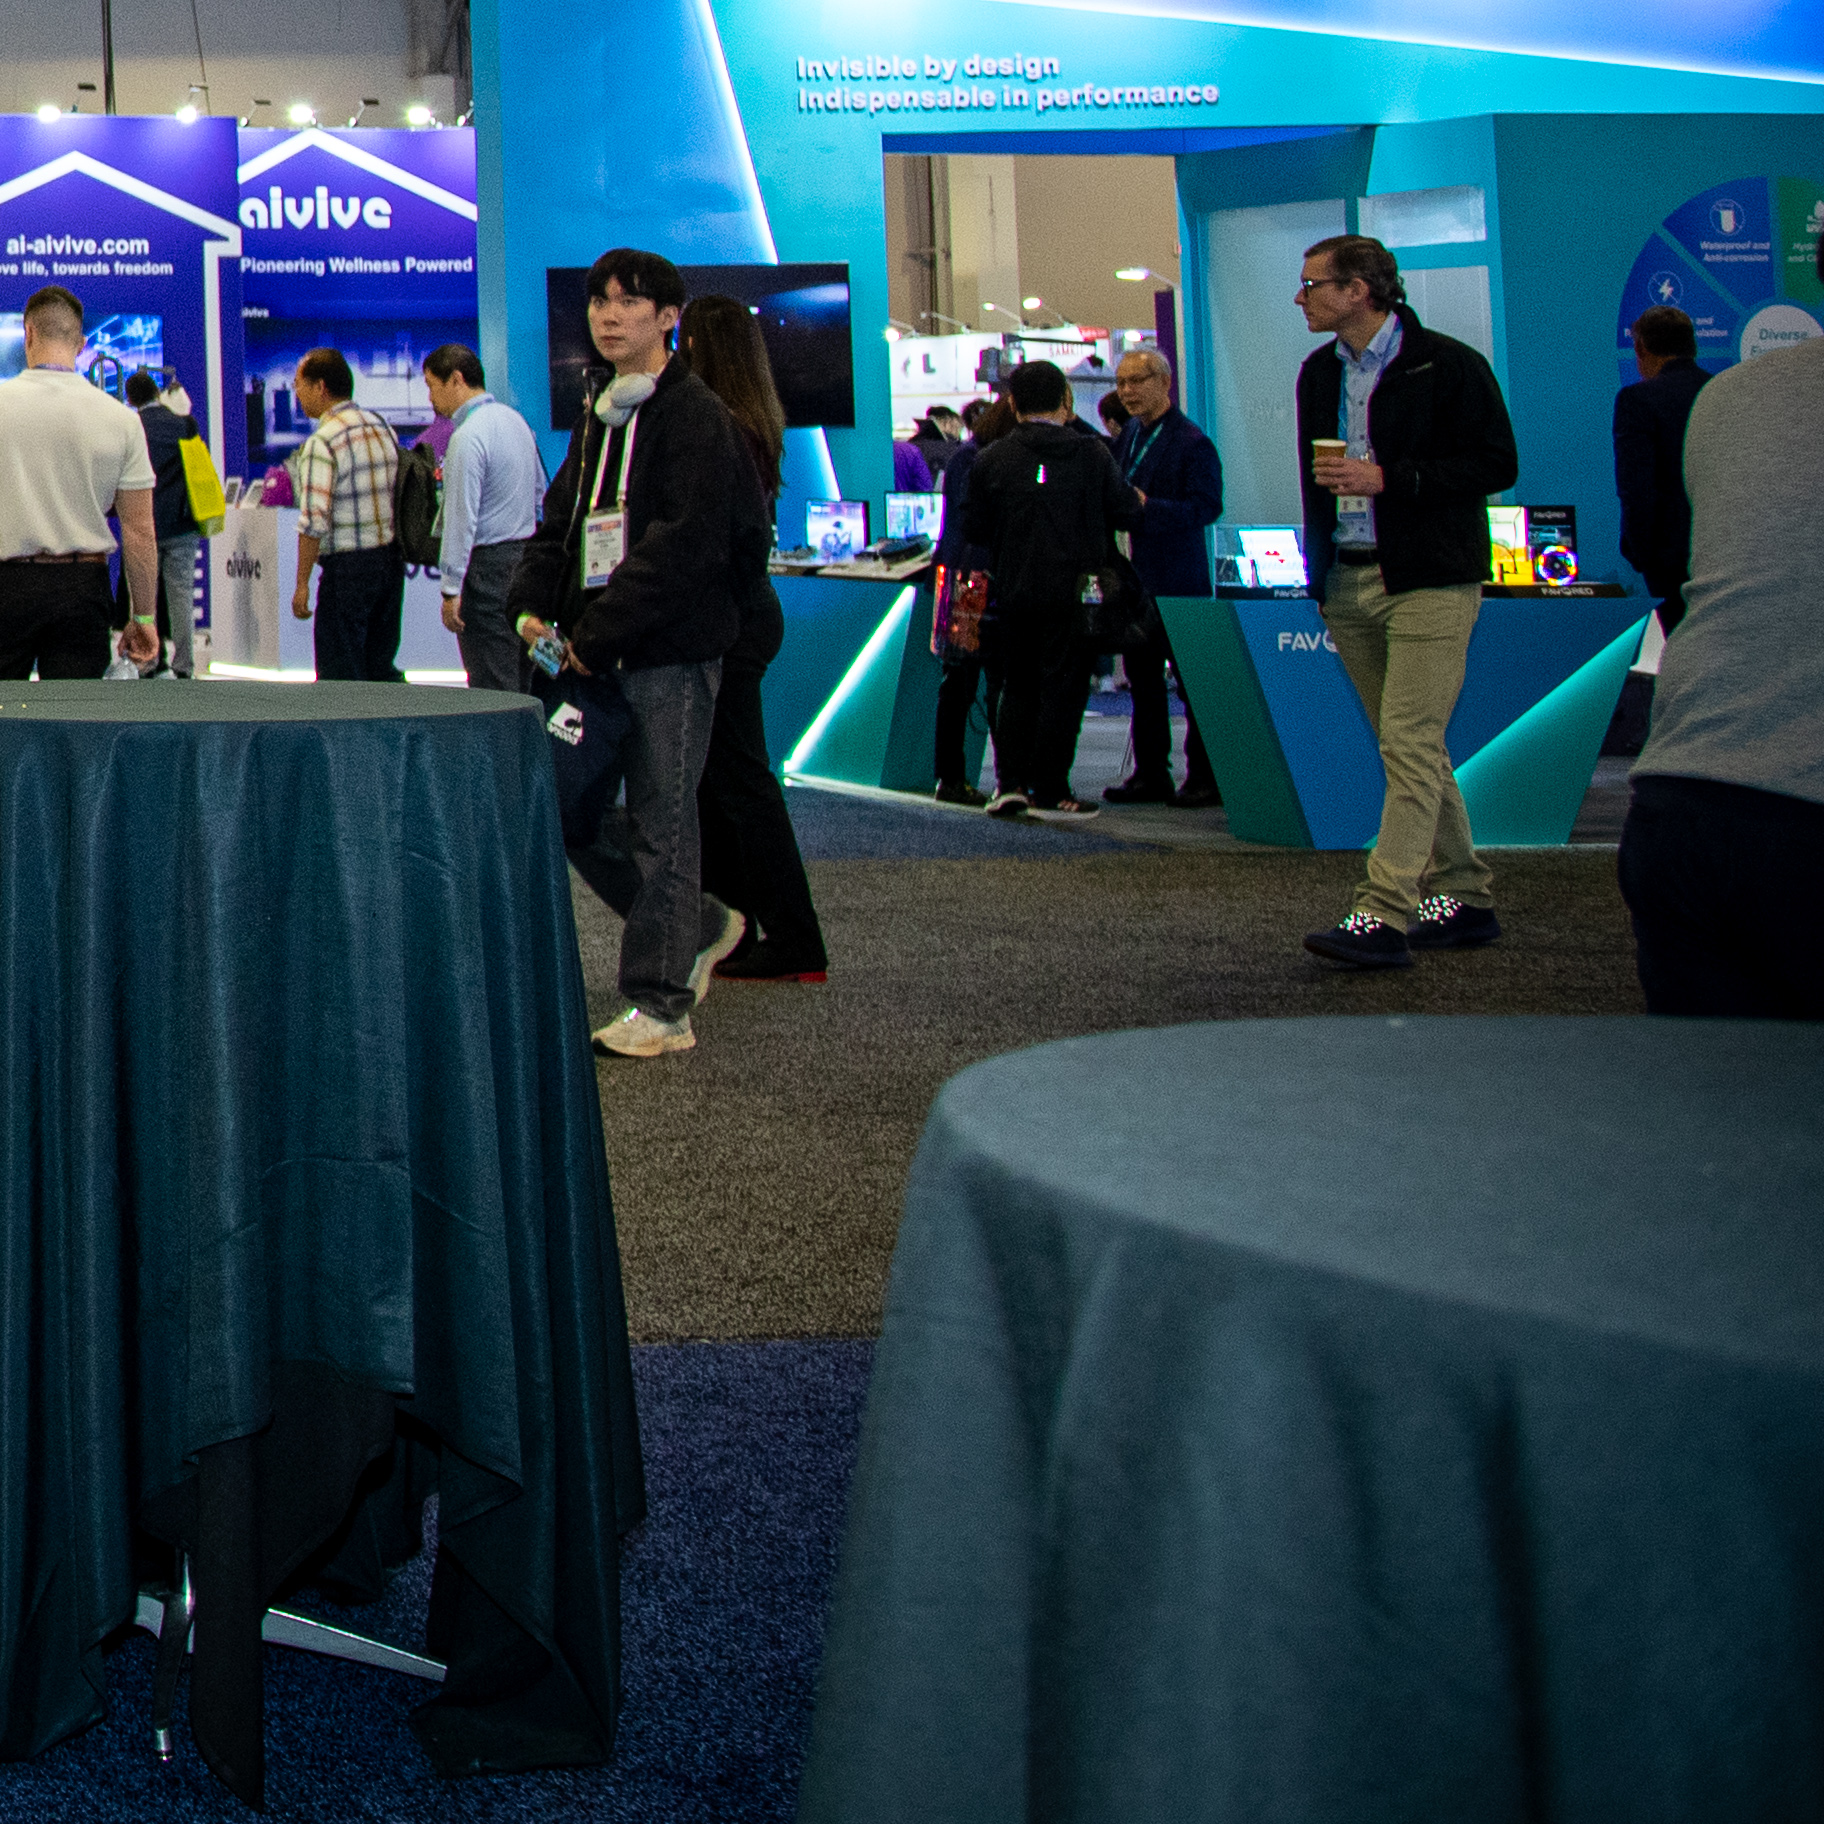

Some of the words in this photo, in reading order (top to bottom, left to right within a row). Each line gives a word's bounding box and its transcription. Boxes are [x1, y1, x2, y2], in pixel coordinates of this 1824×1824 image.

[796, 54, 918, 80] Invisible
[923, 54, 957, 82] by
[963, 52, 1060, 82] design
[797, 84, 998, 114] Indispensable
[1001, 84, 1030, 109] in
[1036, 82, 1220, 112] performance
[237, 185, 393, 231] aivive
[5, 234, 150, 256] ai-aivive.com
[21, 259, 50, 278] life,
[52, 259, 110, 276] towards
[113, 259, 174, 276] freedom
[239, 256, 325, 277] Pioneering
[328, 257, 401, 274] Wellness
[404, 256, 474, 274] Powered
